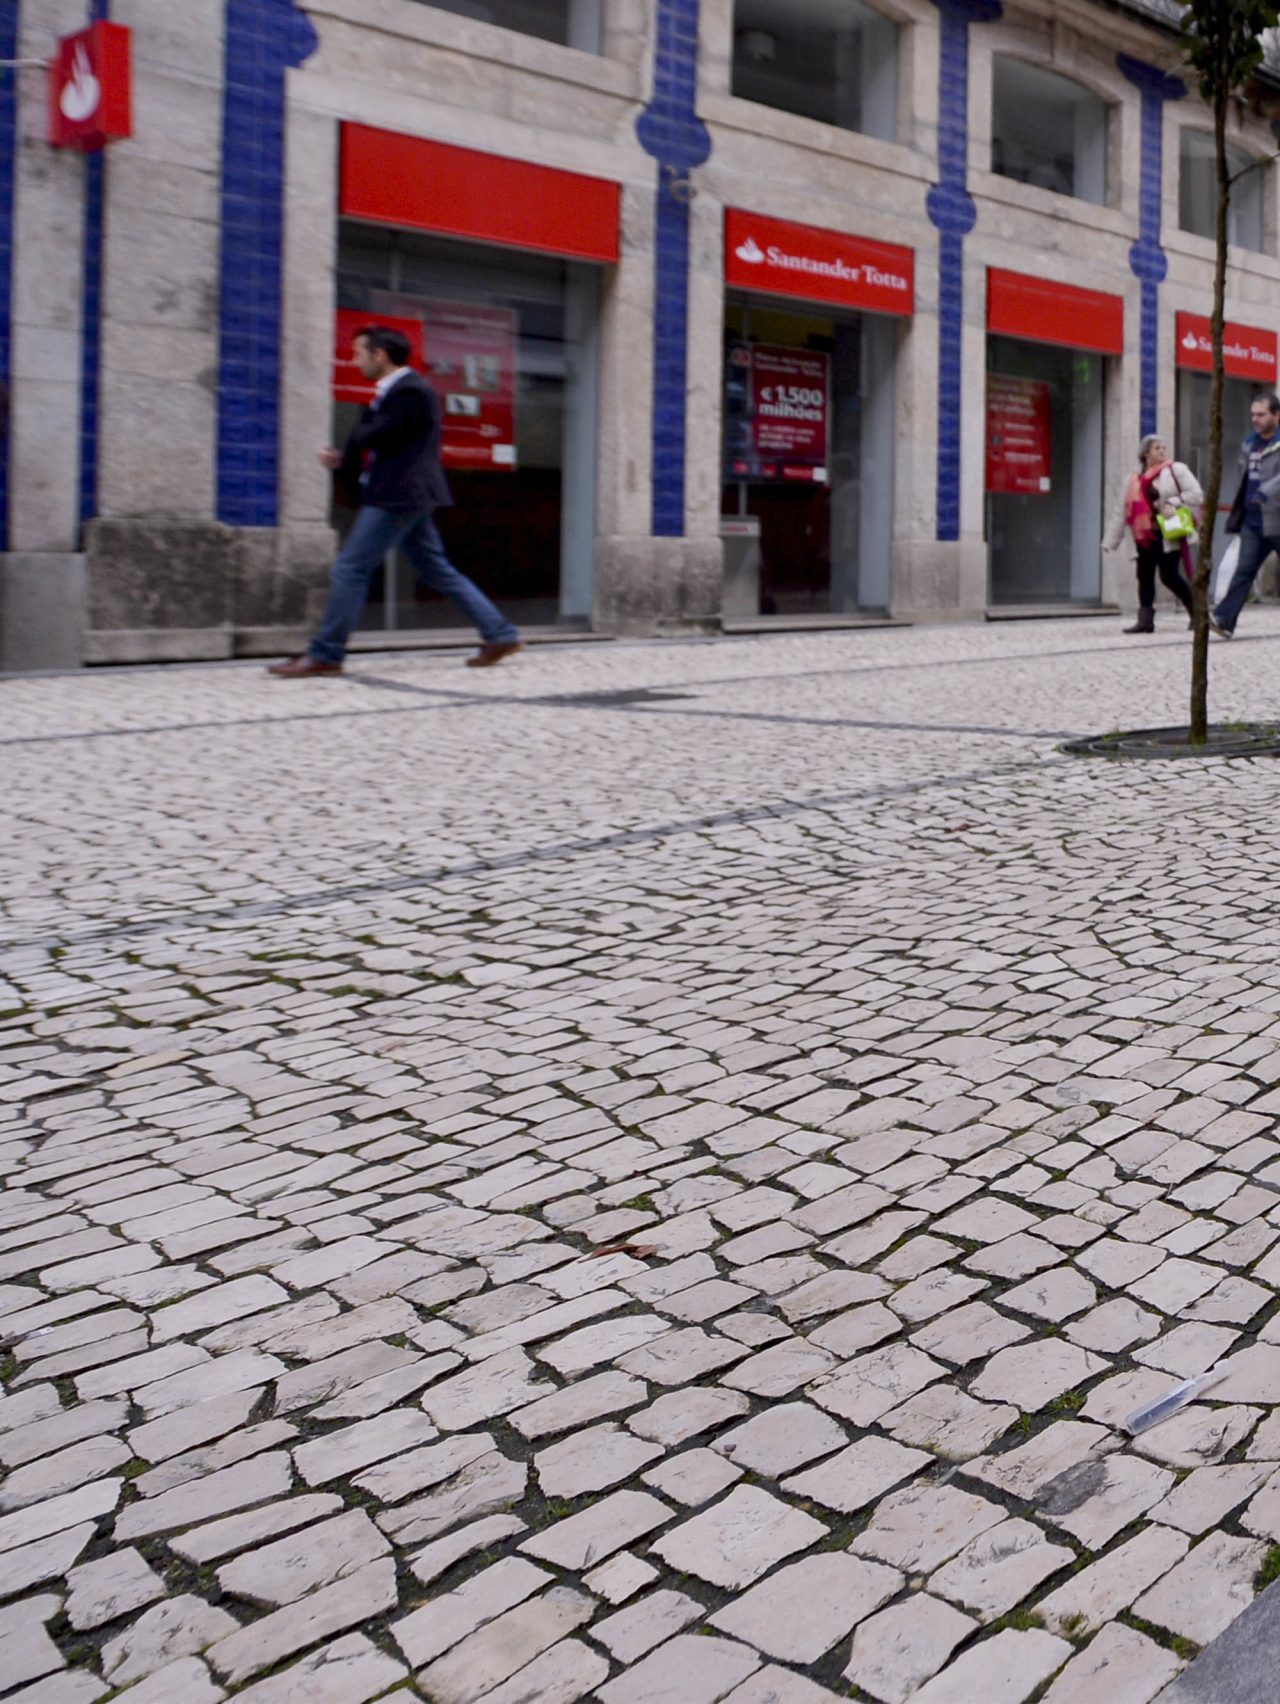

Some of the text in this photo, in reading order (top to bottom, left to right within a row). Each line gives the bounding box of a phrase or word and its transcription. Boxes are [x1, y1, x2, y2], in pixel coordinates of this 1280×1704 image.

[766, 246, 908, 290] Santander Totta
[1249, 346, 1276, 365] Totta
[759, 402, 823, 422] milhões
